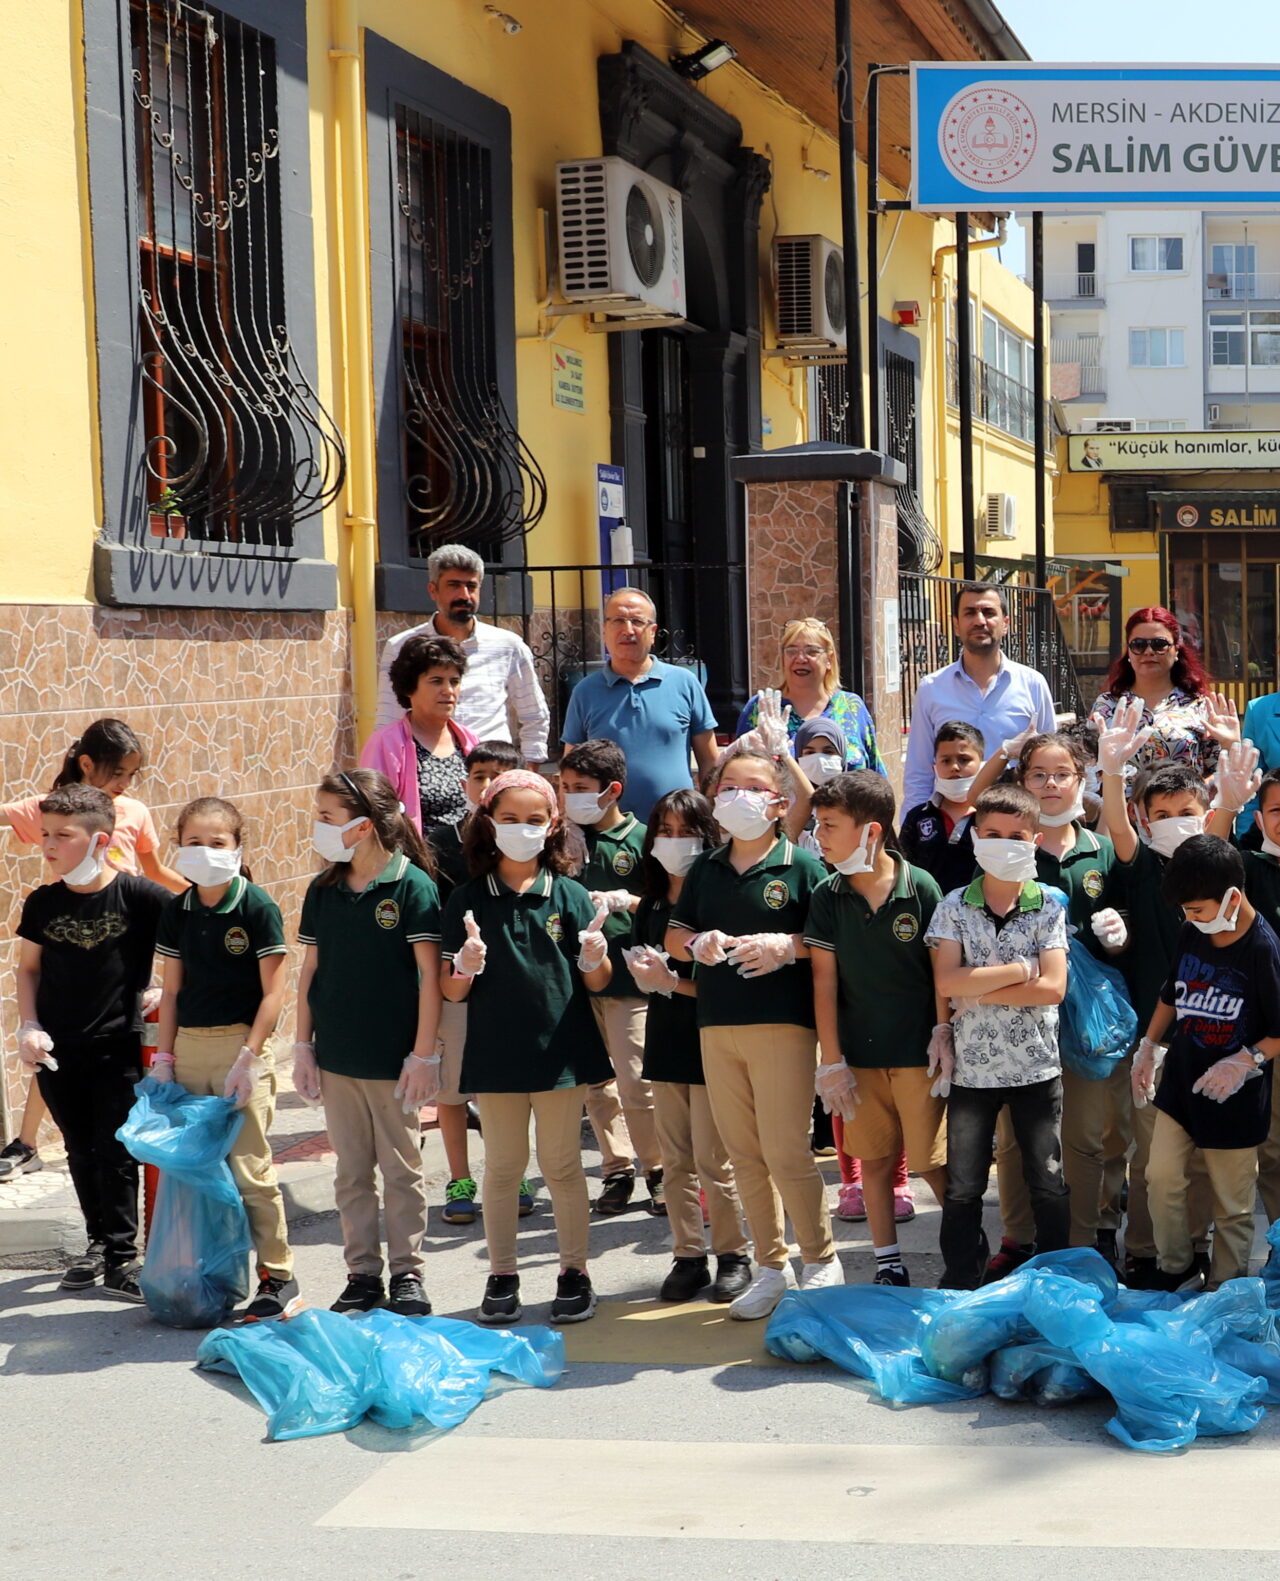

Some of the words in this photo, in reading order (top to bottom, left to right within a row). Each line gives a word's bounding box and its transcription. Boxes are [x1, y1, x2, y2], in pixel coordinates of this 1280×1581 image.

[1052, 98, 1146, 123] MERSİN
[1052, 136, 1171, 174] SALİM
[1175, 439, 1252, 455] hanımlar,
[1210, 504, 1277, 526] SALİM
